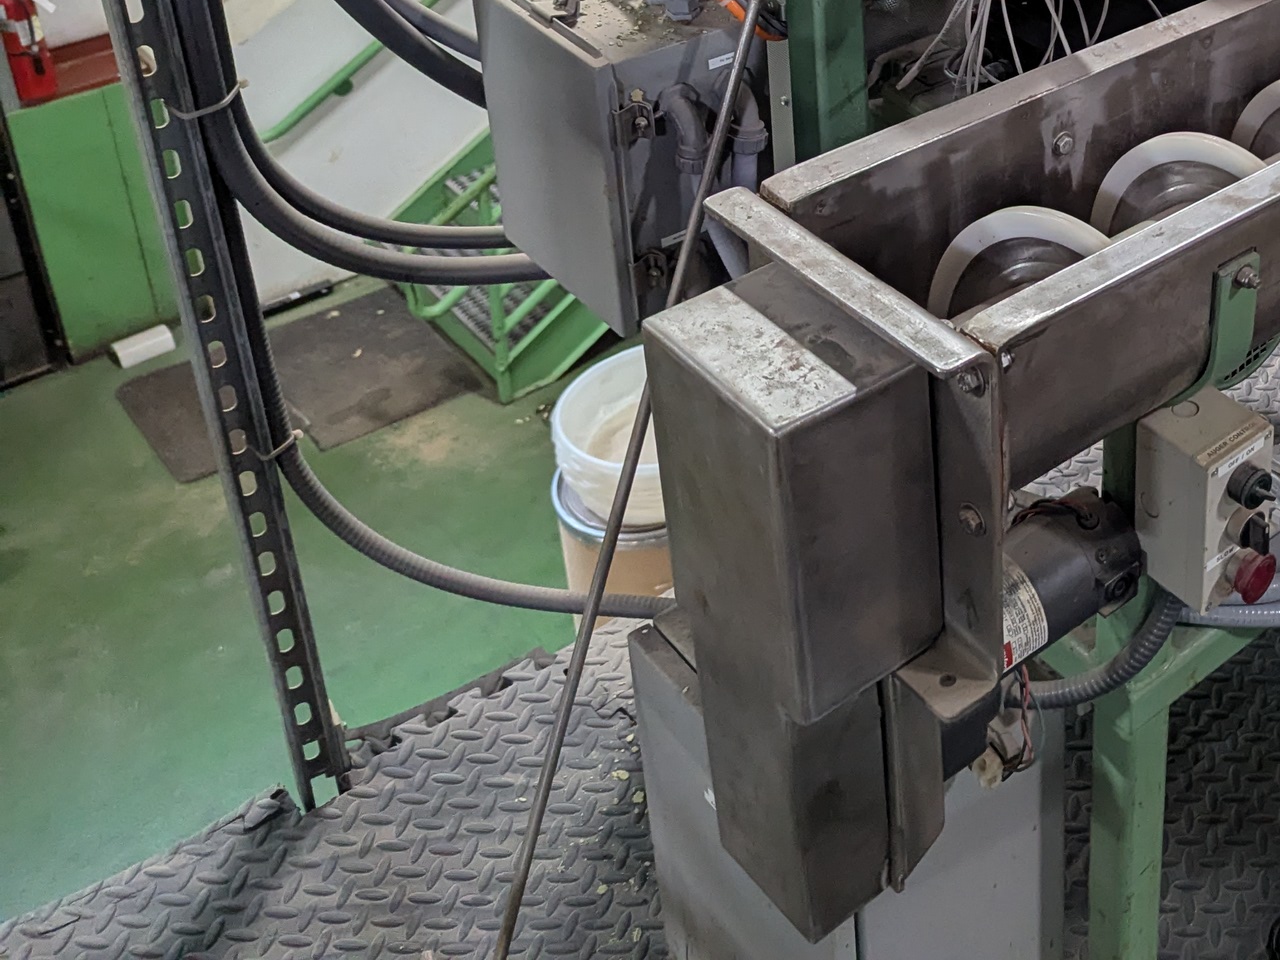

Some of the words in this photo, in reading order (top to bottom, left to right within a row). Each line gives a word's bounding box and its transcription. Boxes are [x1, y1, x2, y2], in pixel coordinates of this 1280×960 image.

[1207, 442, 1228, 458] AUGER
[1229, 422, 1257, 442] CONTRO
[1228, 457, 1239, 468] OFF
[1246, 446, 1255, 455] ON
[1217, 546, 1234, 562] SLOW
